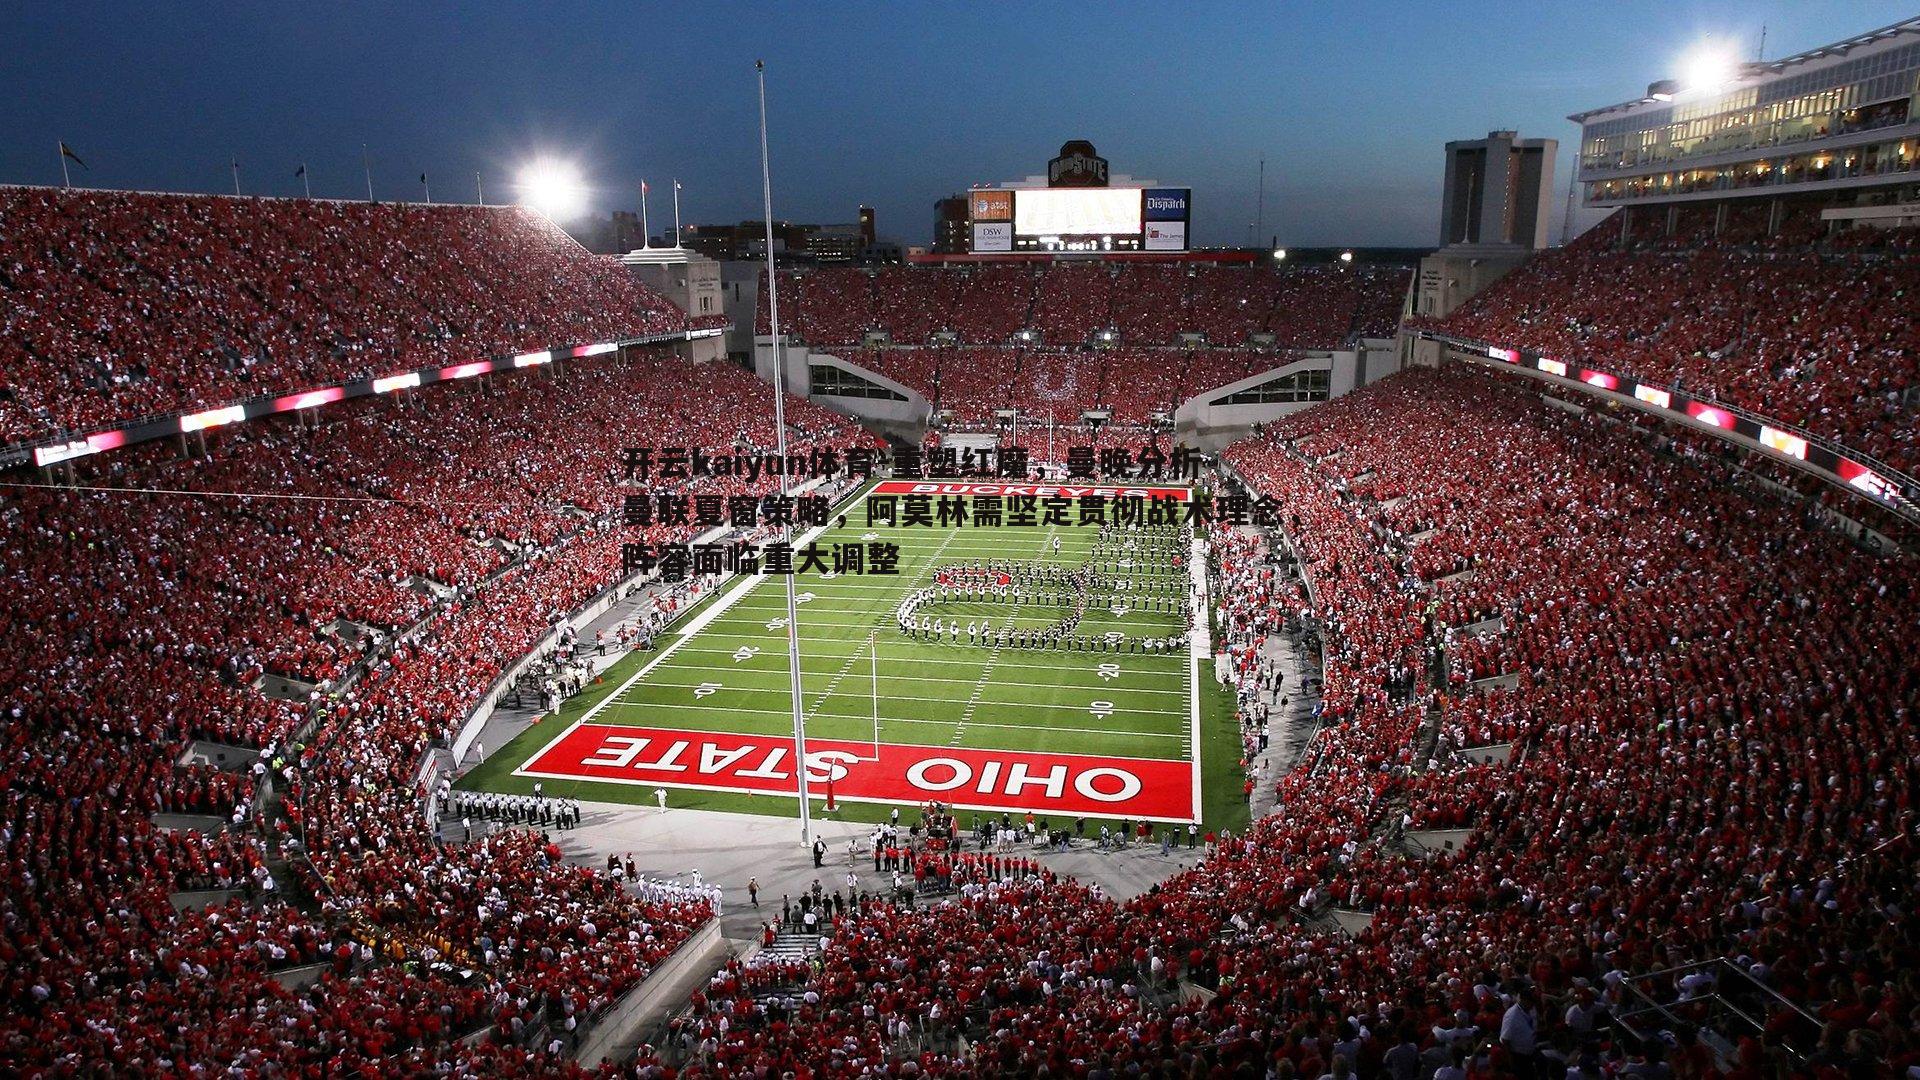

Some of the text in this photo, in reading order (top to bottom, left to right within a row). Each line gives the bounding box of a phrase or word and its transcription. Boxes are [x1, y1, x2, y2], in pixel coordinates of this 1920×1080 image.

[1147, 197, 1185, 211] Dispatch
[983, 228, 1002, 236] DSW
[911, 483, 1150, 497] BUCKEYES
[1097, 663, 1120, 678] 20
[1089, 701, 1114, 715] 10
[582, 735, 1143, 803] OHIO STATE
